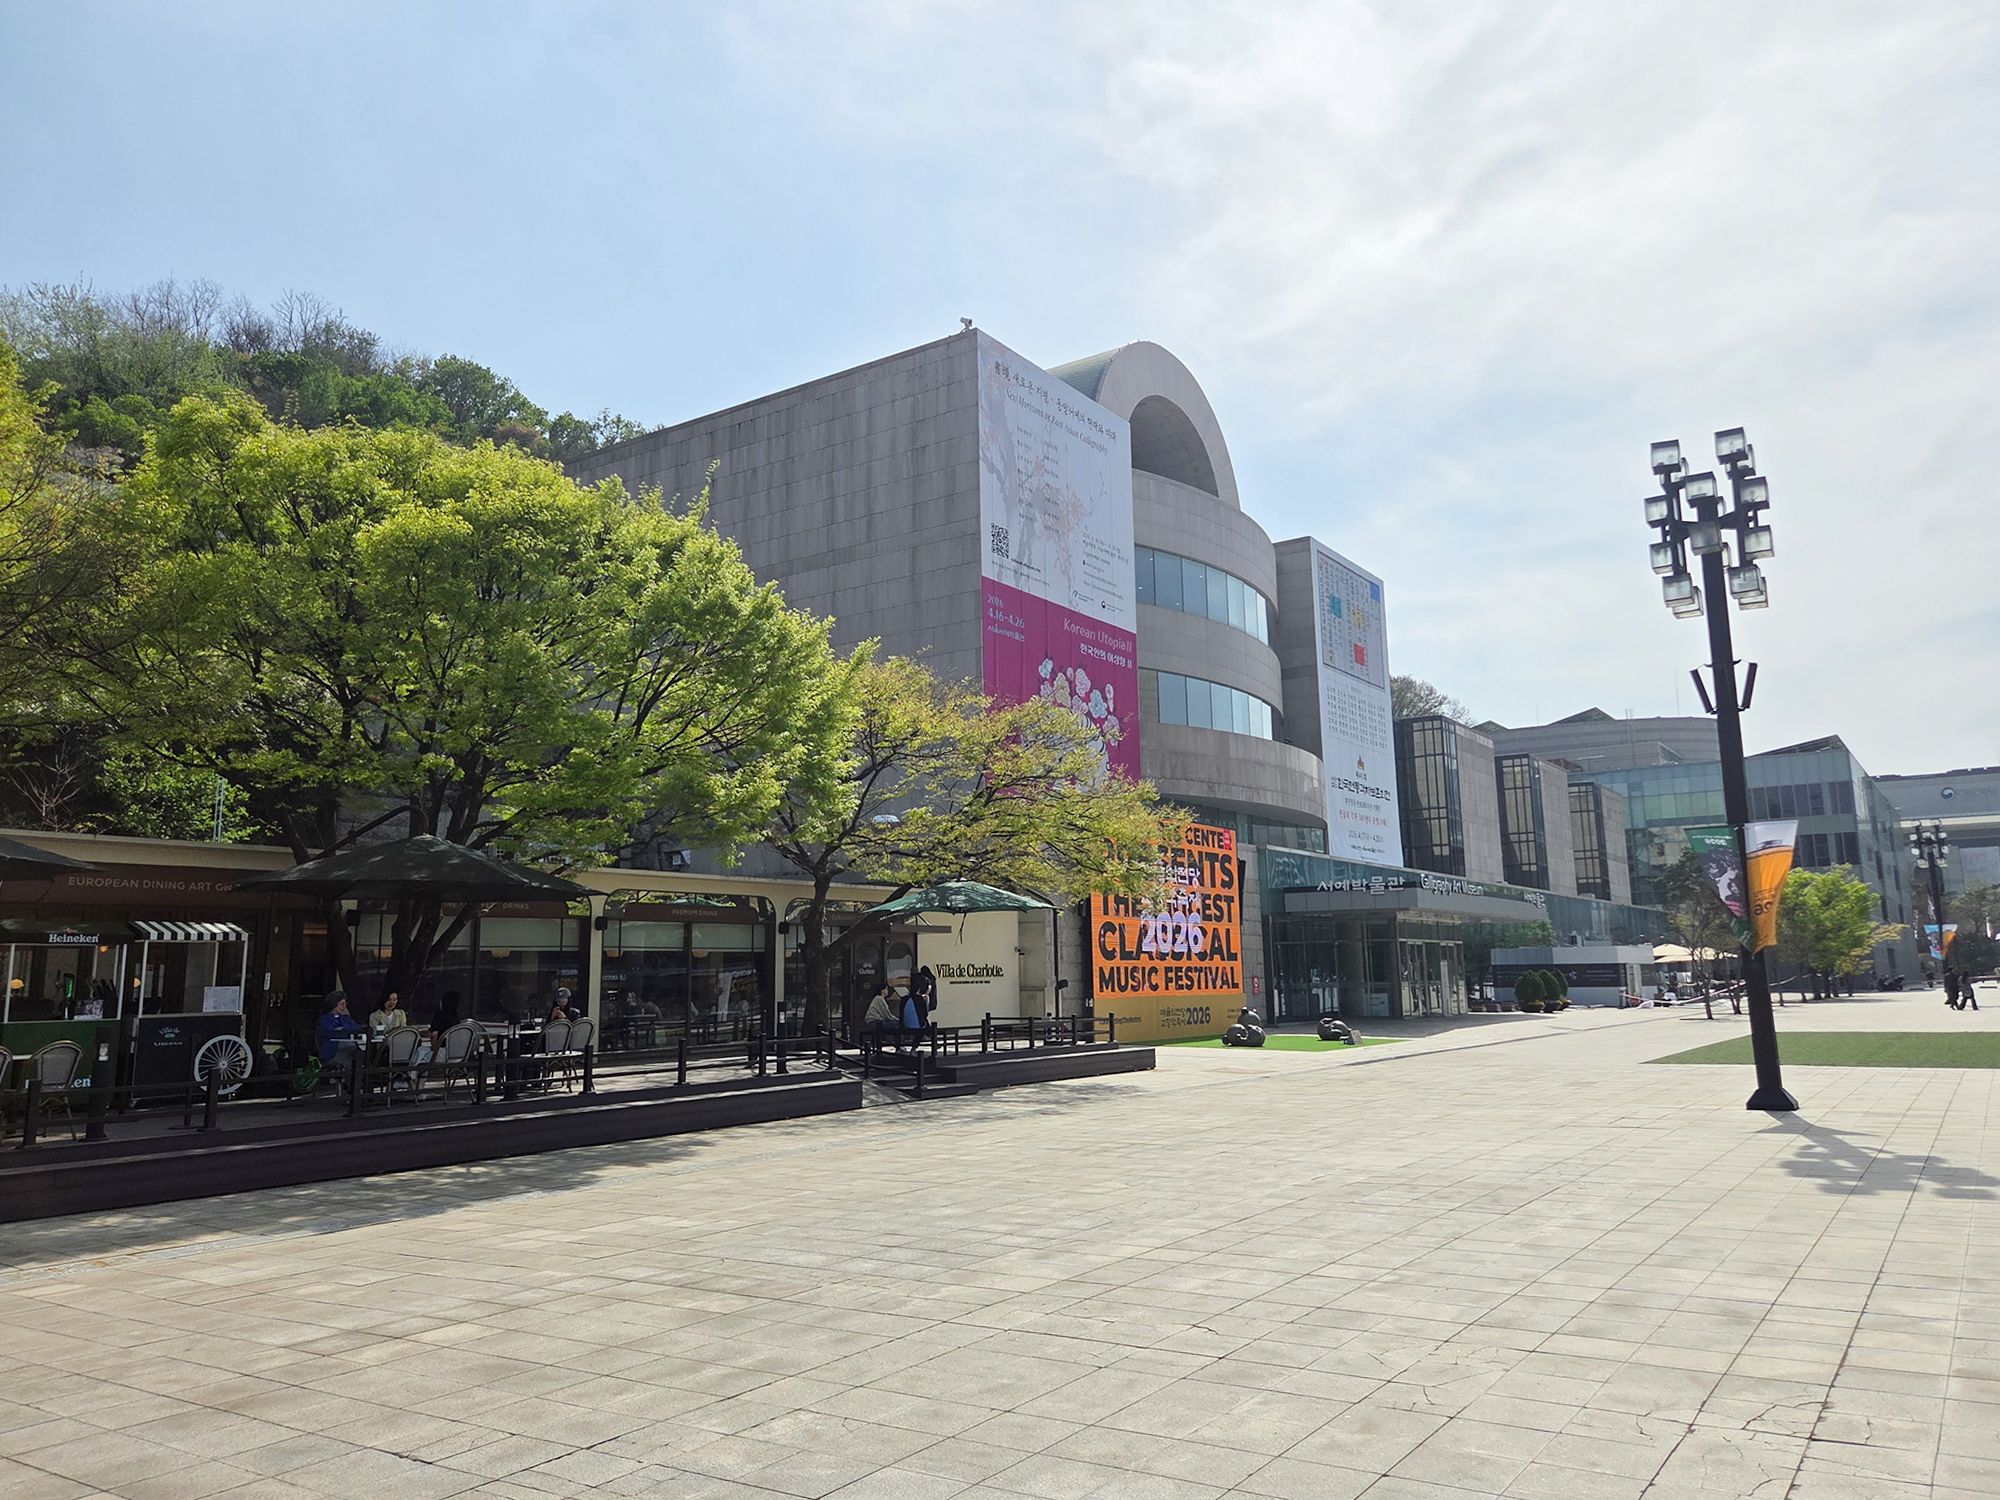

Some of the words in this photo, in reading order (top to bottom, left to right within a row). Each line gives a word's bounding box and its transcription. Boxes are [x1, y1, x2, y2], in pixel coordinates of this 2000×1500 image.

[1063, 618, 1096, 640] Korean
[1097, 630, 1126, 650] Utopia
[68, 876, 139, 888] EUROPEAN
[143, 880, 185, 890] DINING
[188, 883, 213, 891] ART
[1317, 876, 1405, 895] 서예박물관
[49, 933, 99, 943] Heineken
[1141, 911, 1204, 953] 2026
[936, 964, 956, 977] Villa
[956, 964, 966, 977] de
[966, 964, 1004, 977] Charlotte
[1099, 966, 1160, 993] MUSIC
[1164, 965, 1240, 991] FESTIVAL
[1186, 1006, 1211, 1025] 2026
